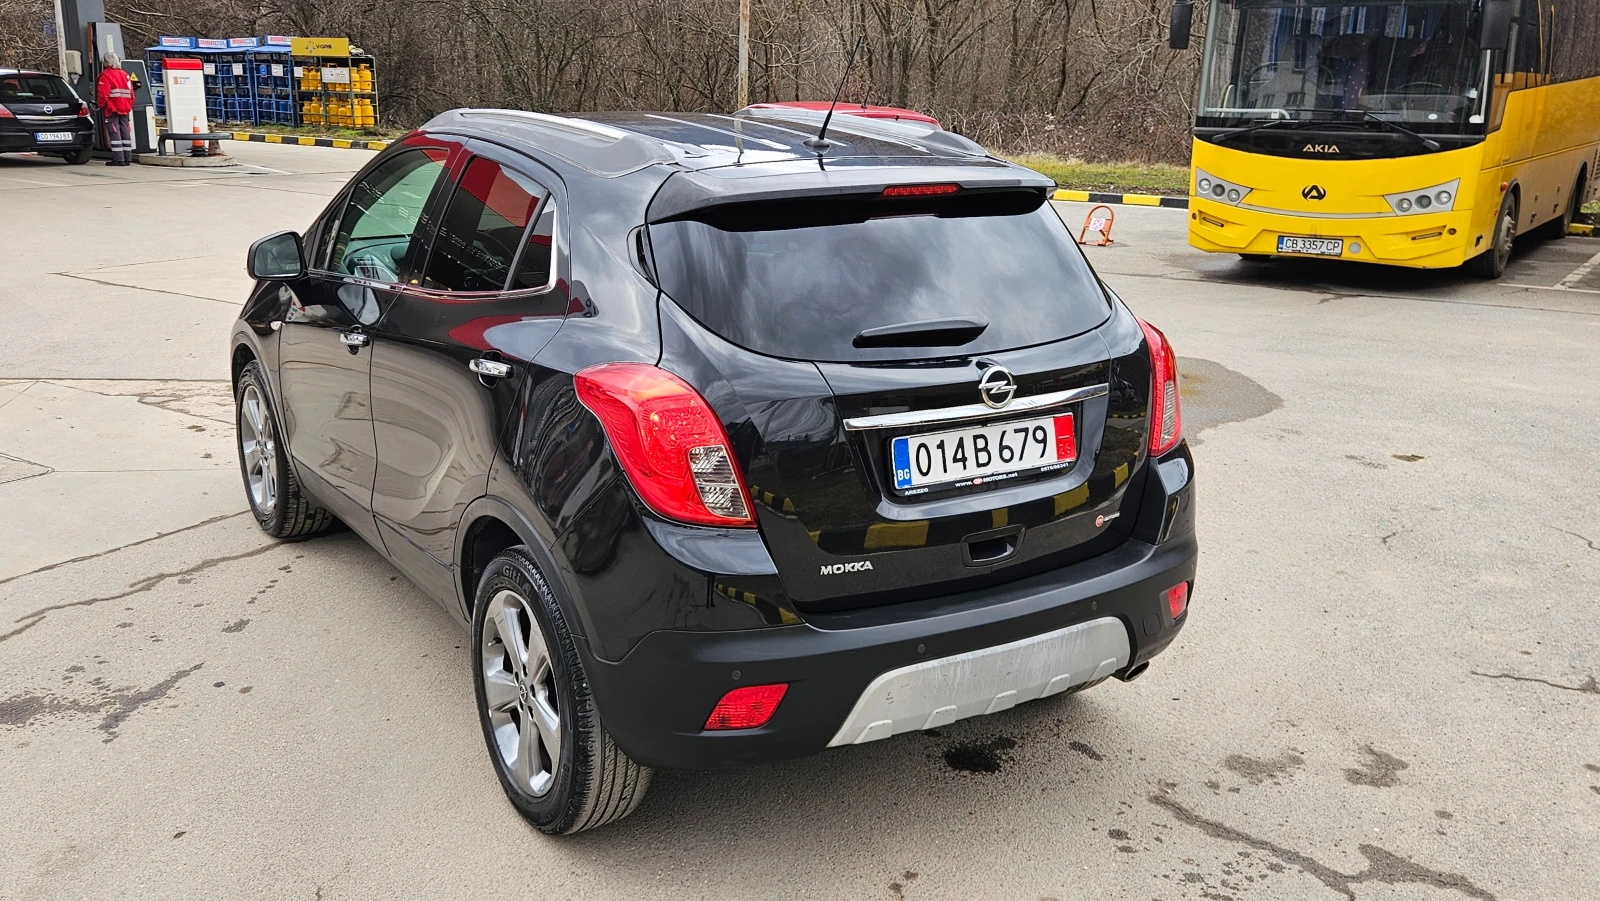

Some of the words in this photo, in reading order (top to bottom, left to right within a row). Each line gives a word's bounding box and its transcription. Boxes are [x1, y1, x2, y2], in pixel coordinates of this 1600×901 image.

[1302, 143, 1340, 154] AKIA
[1285, 238, 1299, 249] CB
[1299, 239, 1325, 251] 3357
[1325, 241, 1340, 252] CP
[897, 468, 910, 481] BG
[502, 565, 521, 584] Giti
[820, 560, 874, 576] MOKKA
